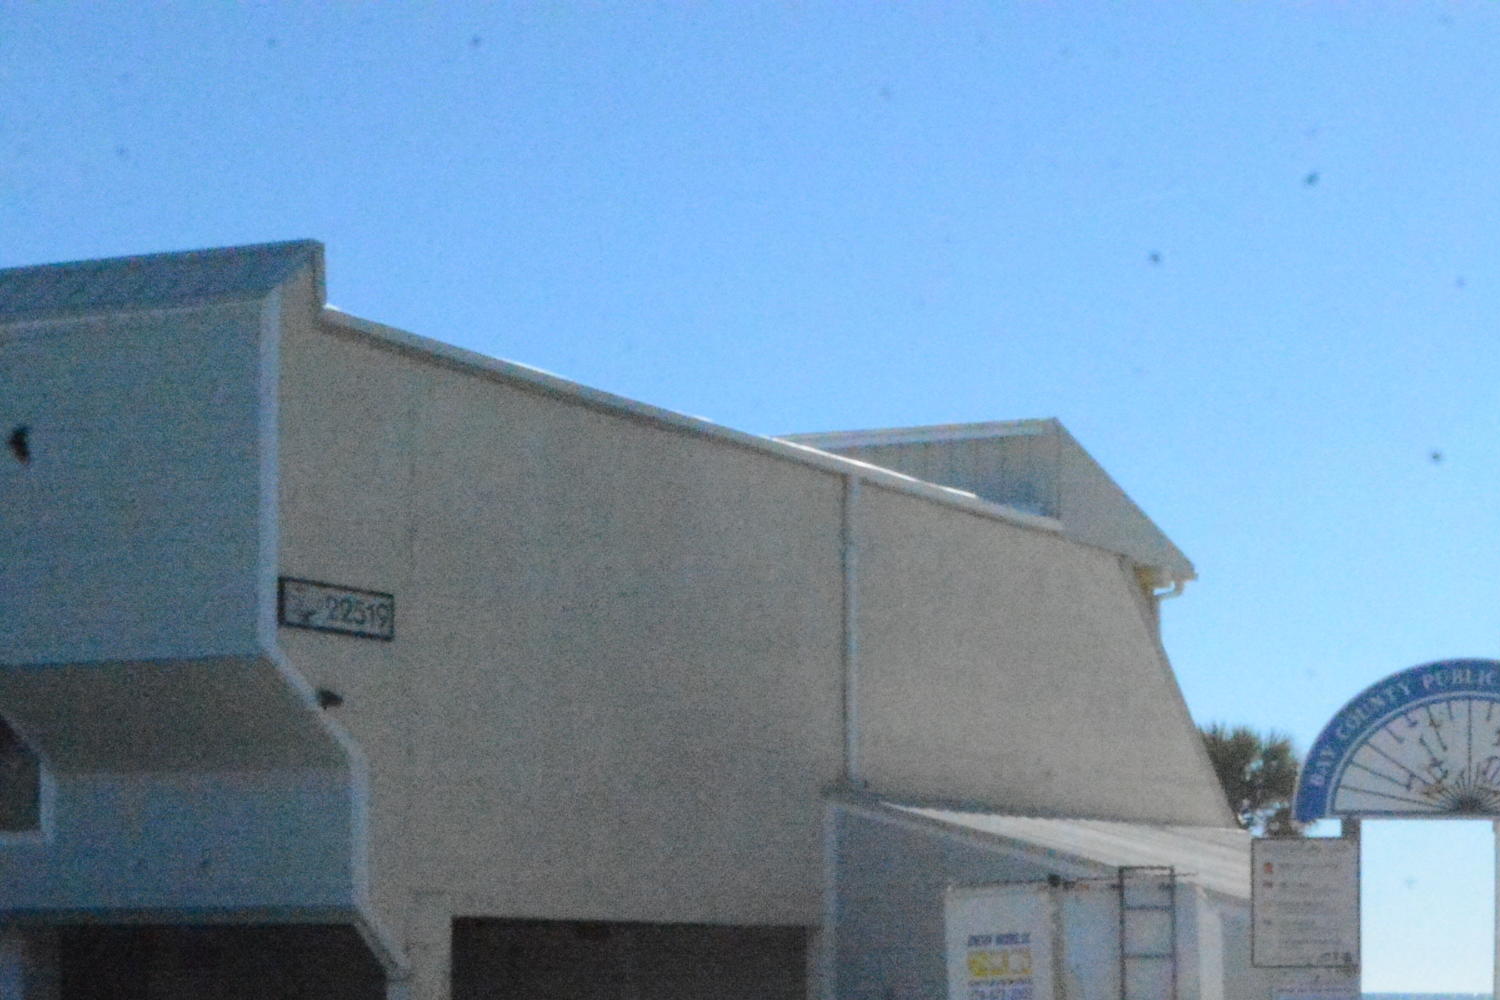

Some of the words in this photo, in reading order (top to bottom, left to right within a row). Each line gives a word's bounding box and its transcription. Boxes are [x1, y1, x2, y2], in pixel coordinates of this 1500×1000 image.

[325, 594, 390, 629] 22519
[1309, 744, 1337, 788] BAY
[1334, 682, 1412, 742] COUNTY
[1421, 668, 1496, 690] PUBLIC
